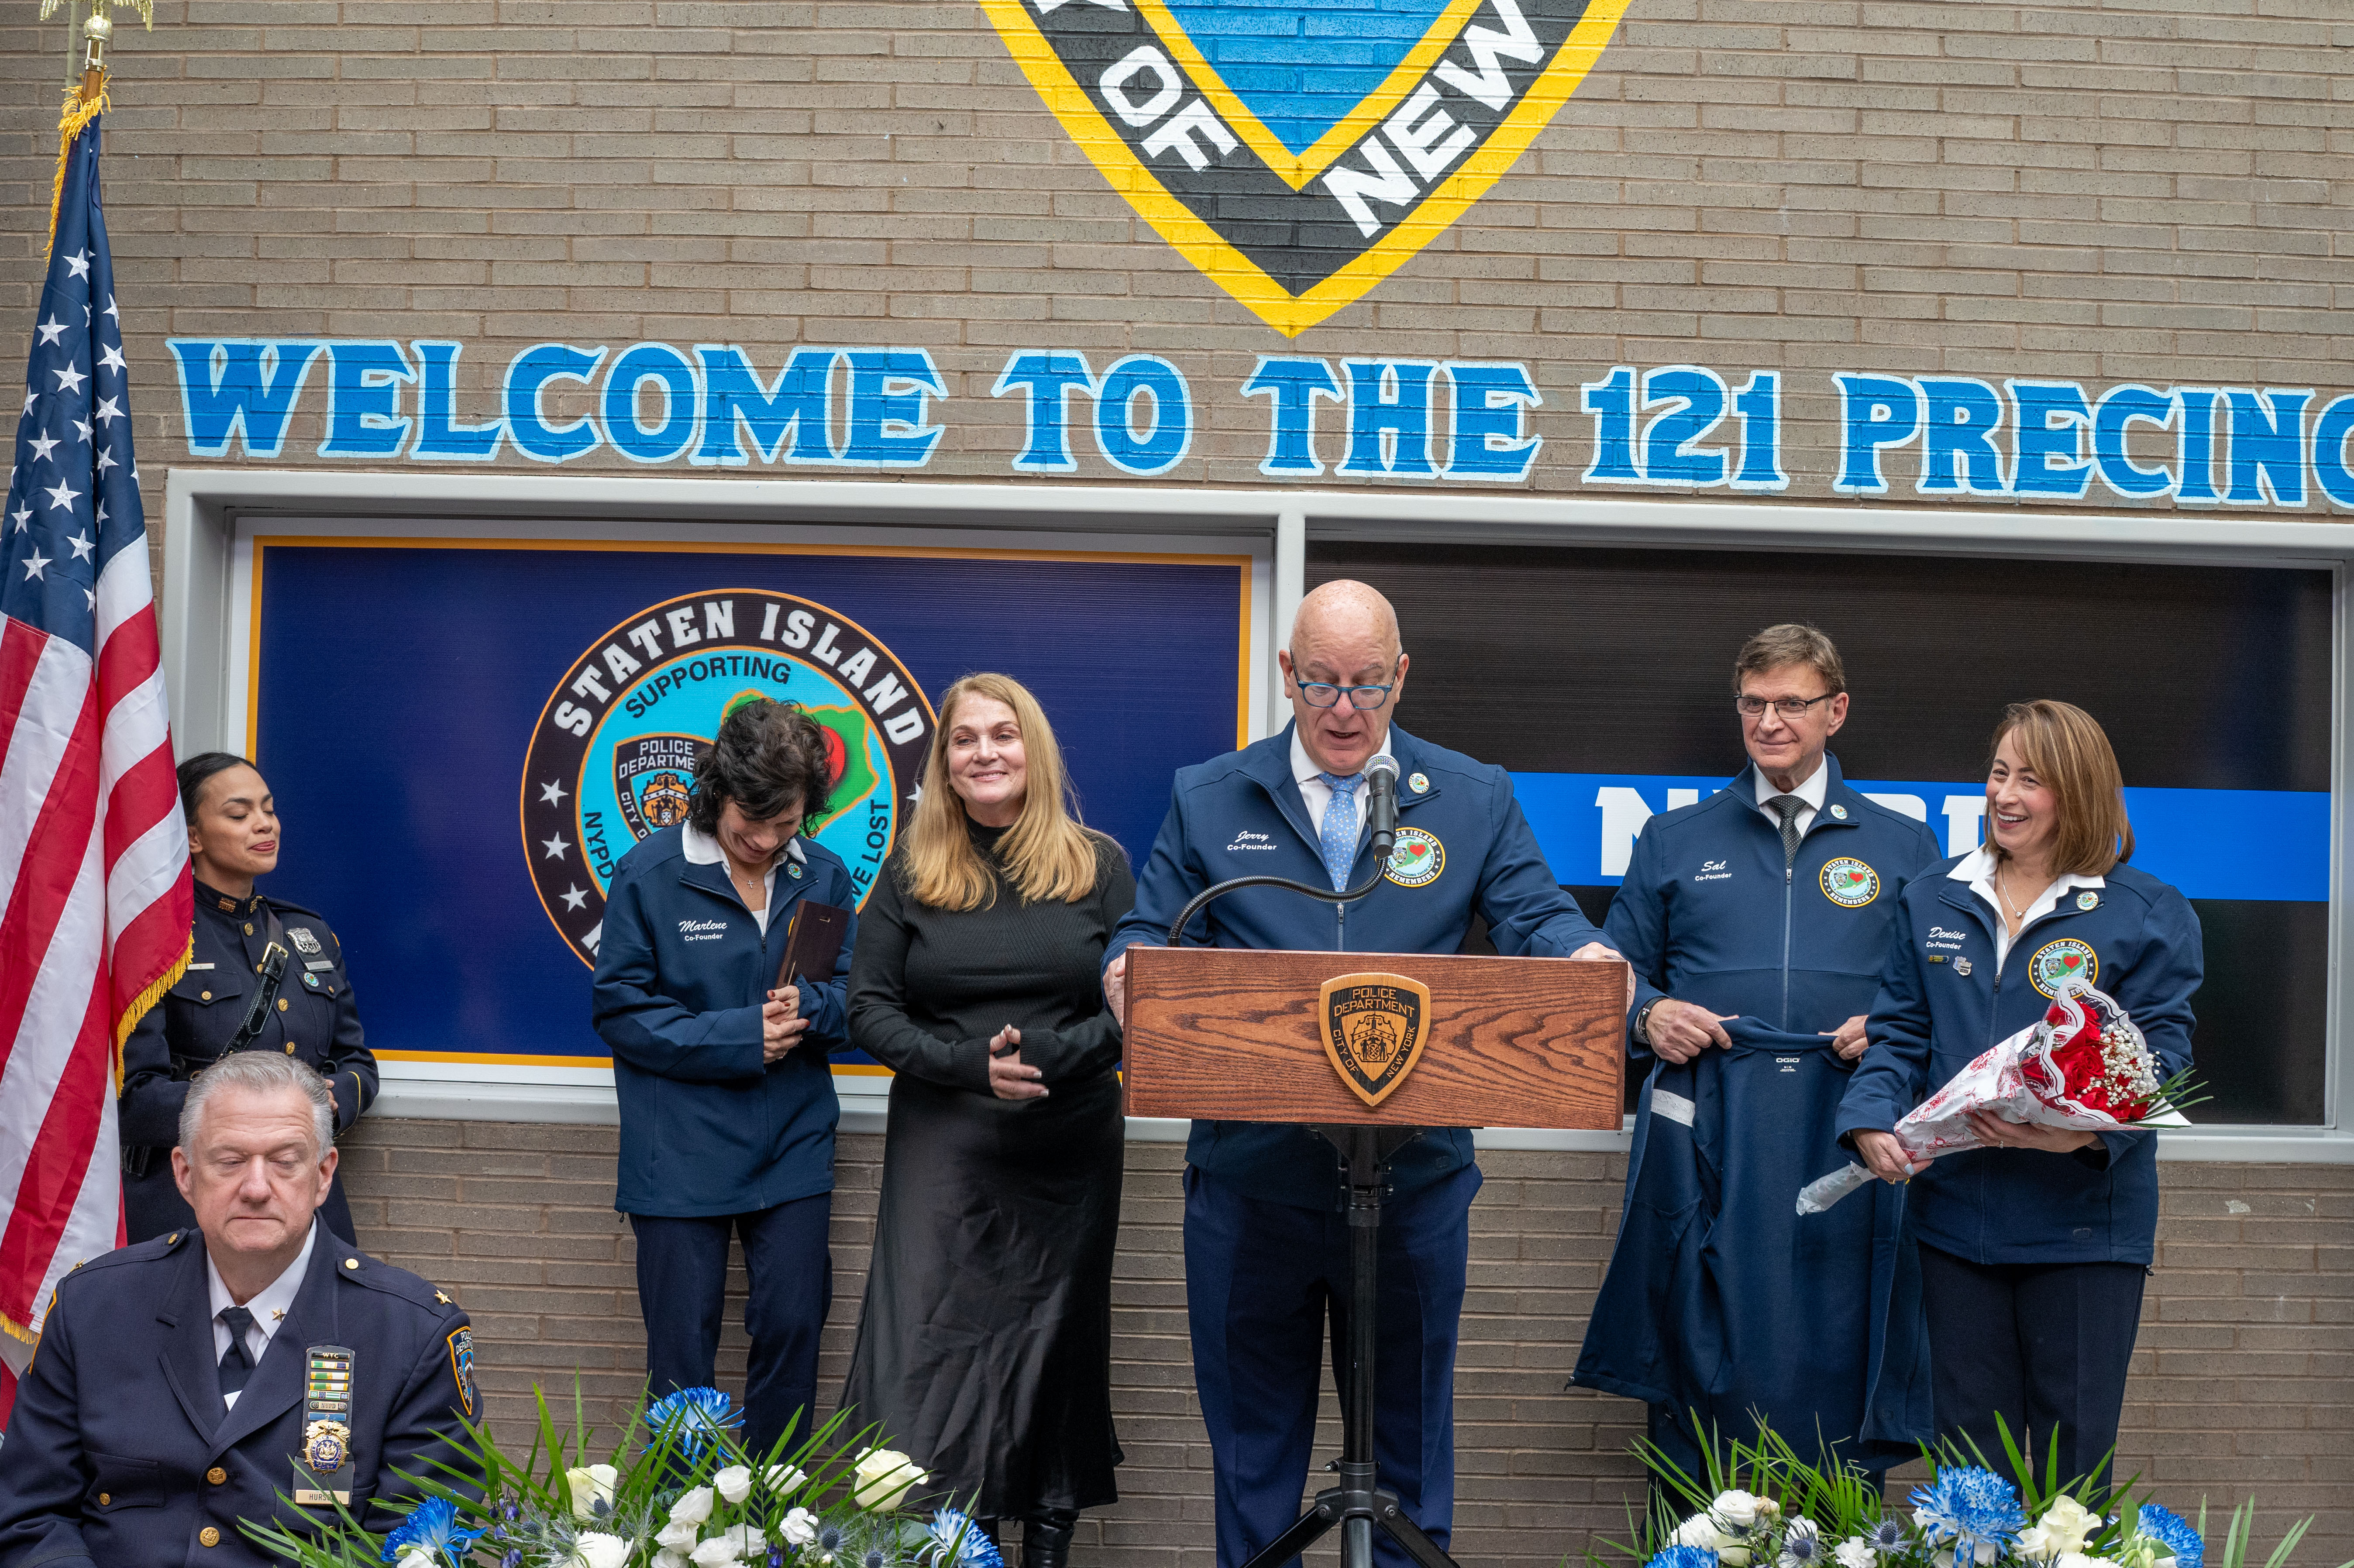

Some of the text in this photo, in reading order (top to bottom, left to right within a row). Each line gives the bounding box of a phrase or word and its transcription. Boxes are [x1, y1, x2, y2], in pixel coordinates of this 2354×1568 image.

[1099, 45, 1239, 173] OF
[1322, 0, 1545, 238] NEW
[166, 337, 948, 467] WELCOME
[990, 350, 1194, 476] TO
[1239, 355, 1544, 482] THE
[1580, 364, 1790, 490] 121
[554, 600, 925, 746] STATEN ISLAND
[625, 656, 792, 719] SUPPORTING
[640, 740, 694, 755] POLICE
[619, 754, 695, 779] DEPARTME
[620, 791, 640, 823] CITY
[862, 799, 889, 863] LOST
[1235, 830, 1269, 843] Jerry
[1410, 830, 1438, 847] ISLAND
[584, 812, 615, 879] NYPD
[1427, 862, 1433, 870] WE
[1701, 860, 1726, 871] Sal
[1825, 860, 1874, 877] STATEN ISLAND
[1389, 870, 1435, 884] REMEMBERS
[1695, 872, 1732, 881] Co-Founder
[1829, 892, 1870, 904] REMEMBERS
[678, 919, 728, 932] Marlene
[1928, 926, 1966, 940] Denise
[685, 933, 723, 941] Co-Founder
[1926, 941, 1962, 950] Co-Founder
[2037, 941, 2092, 959] STATEN ISLAND
[2048, 948, 2073, 956] SUPPORTING
[2046, 980, 2060, 989] HONOR
[1353, 988, 1396, 999] POLICE
[1334, 999, 1415, 1018] DEPARTMENT
[1333, 1029, 1359, 1072] CITY OF
[1386, 1026, 1416, 1078] NEW YORK
